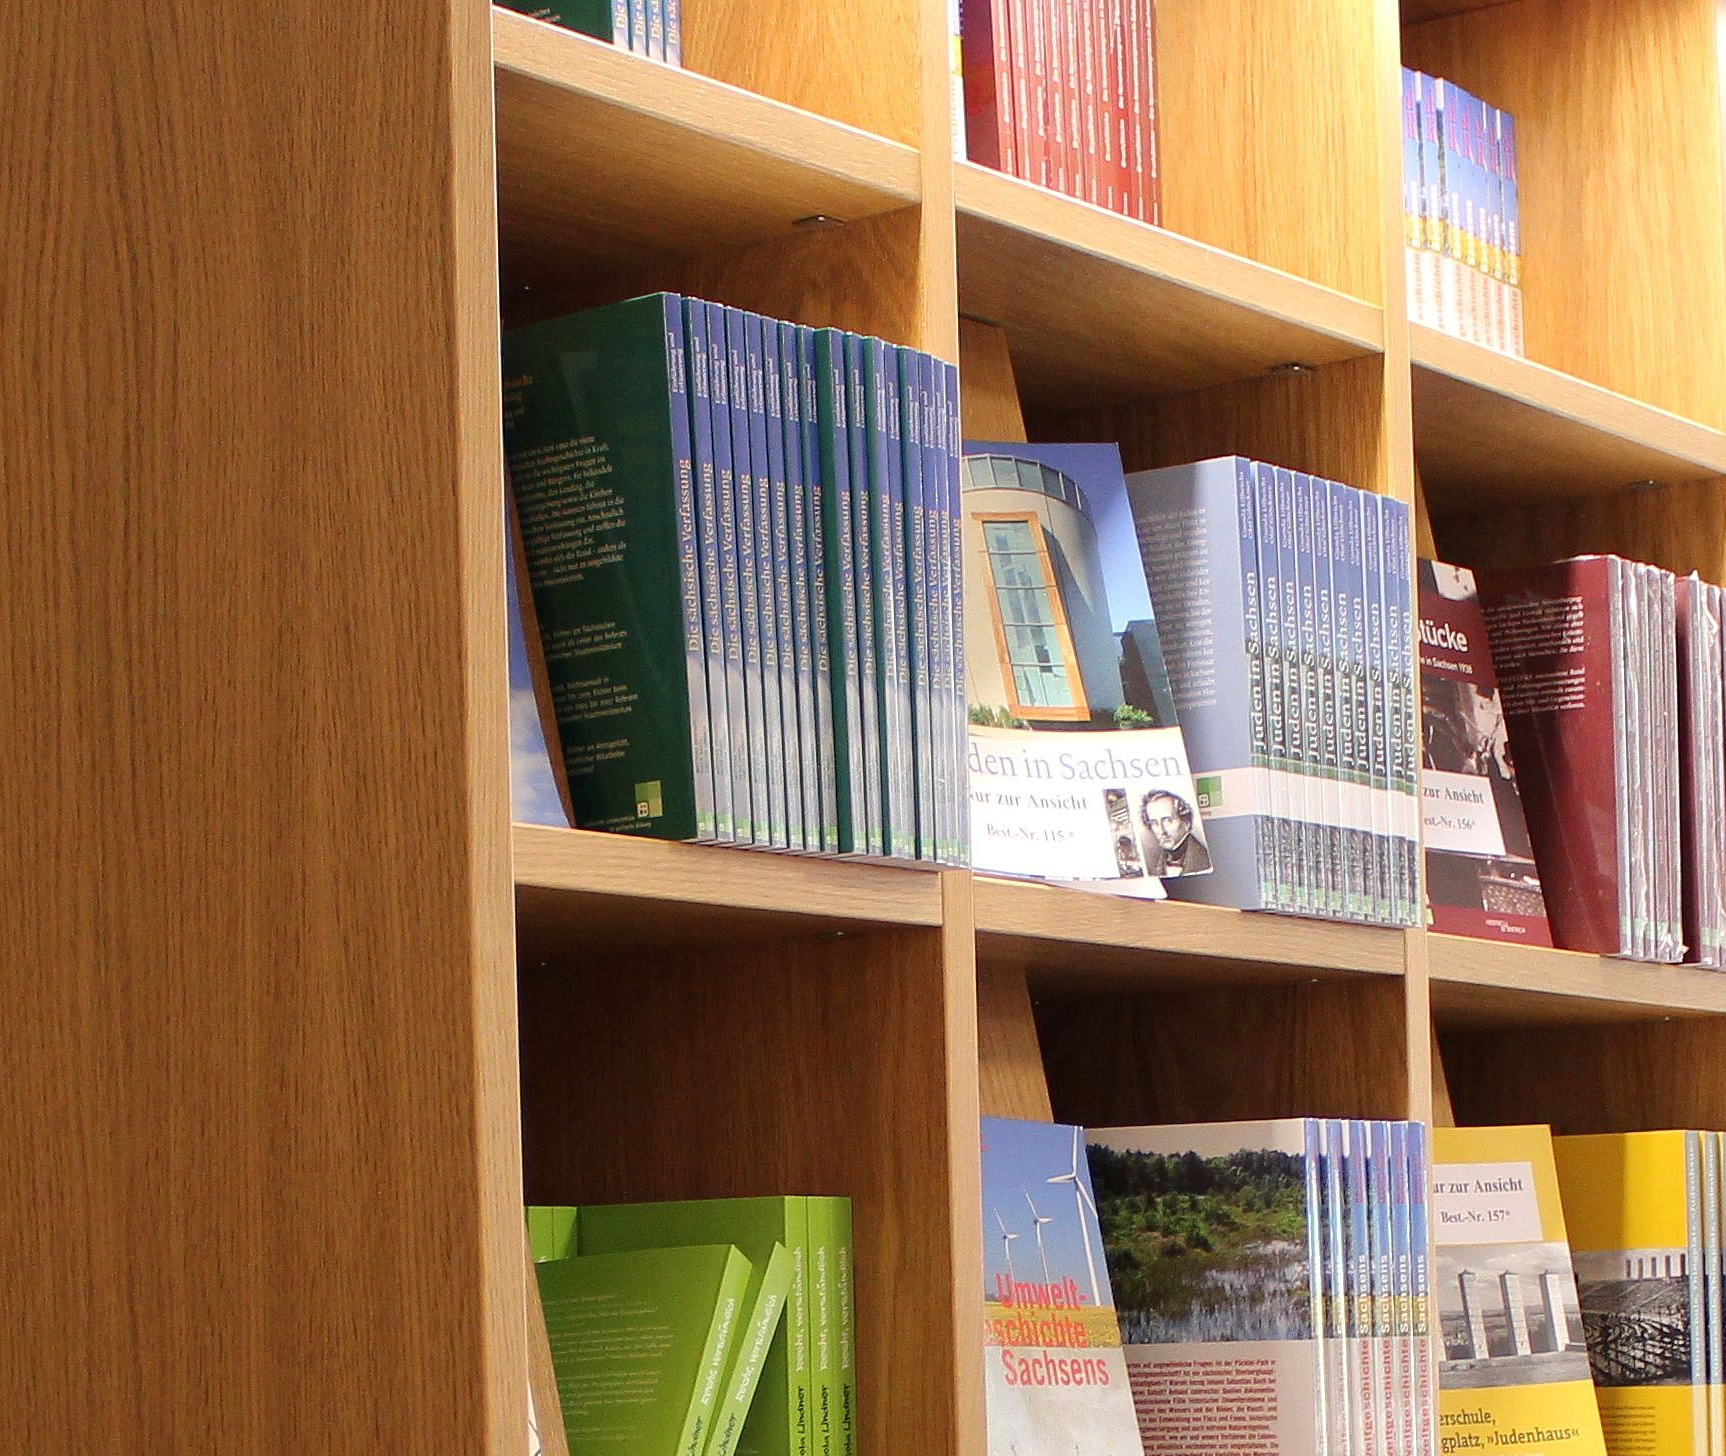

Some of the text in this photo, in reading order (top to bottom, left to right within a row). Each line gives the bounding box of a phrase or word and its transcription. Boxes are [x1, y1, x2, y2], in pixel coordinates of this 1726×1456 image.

[679, 459, 699, 653] Die sächsische Verfassung
[703, 462, 720, 656] Die sächsische Verfassung
[721, 469, 739, 661] Die sächsische Verfassung
[740, 473, 758, 665] Die sächsische Verfassung
[1245, 572, 1267, 753] Juden in Sachsen
[1266, 576, 1286, 757] Juden in Sachsen
[1284, 581, 1303, 761] Juden in Sachsen
[1301, 585, 1320, 763] Juden in Sachsen
[996, 793, 1089, 811] zur Ansicht
[1024, 747, 1183, 781] in Sachsen
[1443, 786, 1484, 805] Ansicht
[1441, 1210, 1484, 1224] Best.-Nr.
[1448, 1176, 1524, 1195] zur Ansicht
[996, 1273, 1088, 1312] Umwelt-
[1358, 1254, 1370, 1337] Sachsens
[1378, 1254, 1390, 1337] Sachsens
[1398, 1254, 1409, 1337] Sachsens
[1417, 1254, 1427, 1333] Sachsens
[1002, 1351, 1111, 1387] Sachsens
[1487, 1426, 1580, 1446] »Judenhaus«
